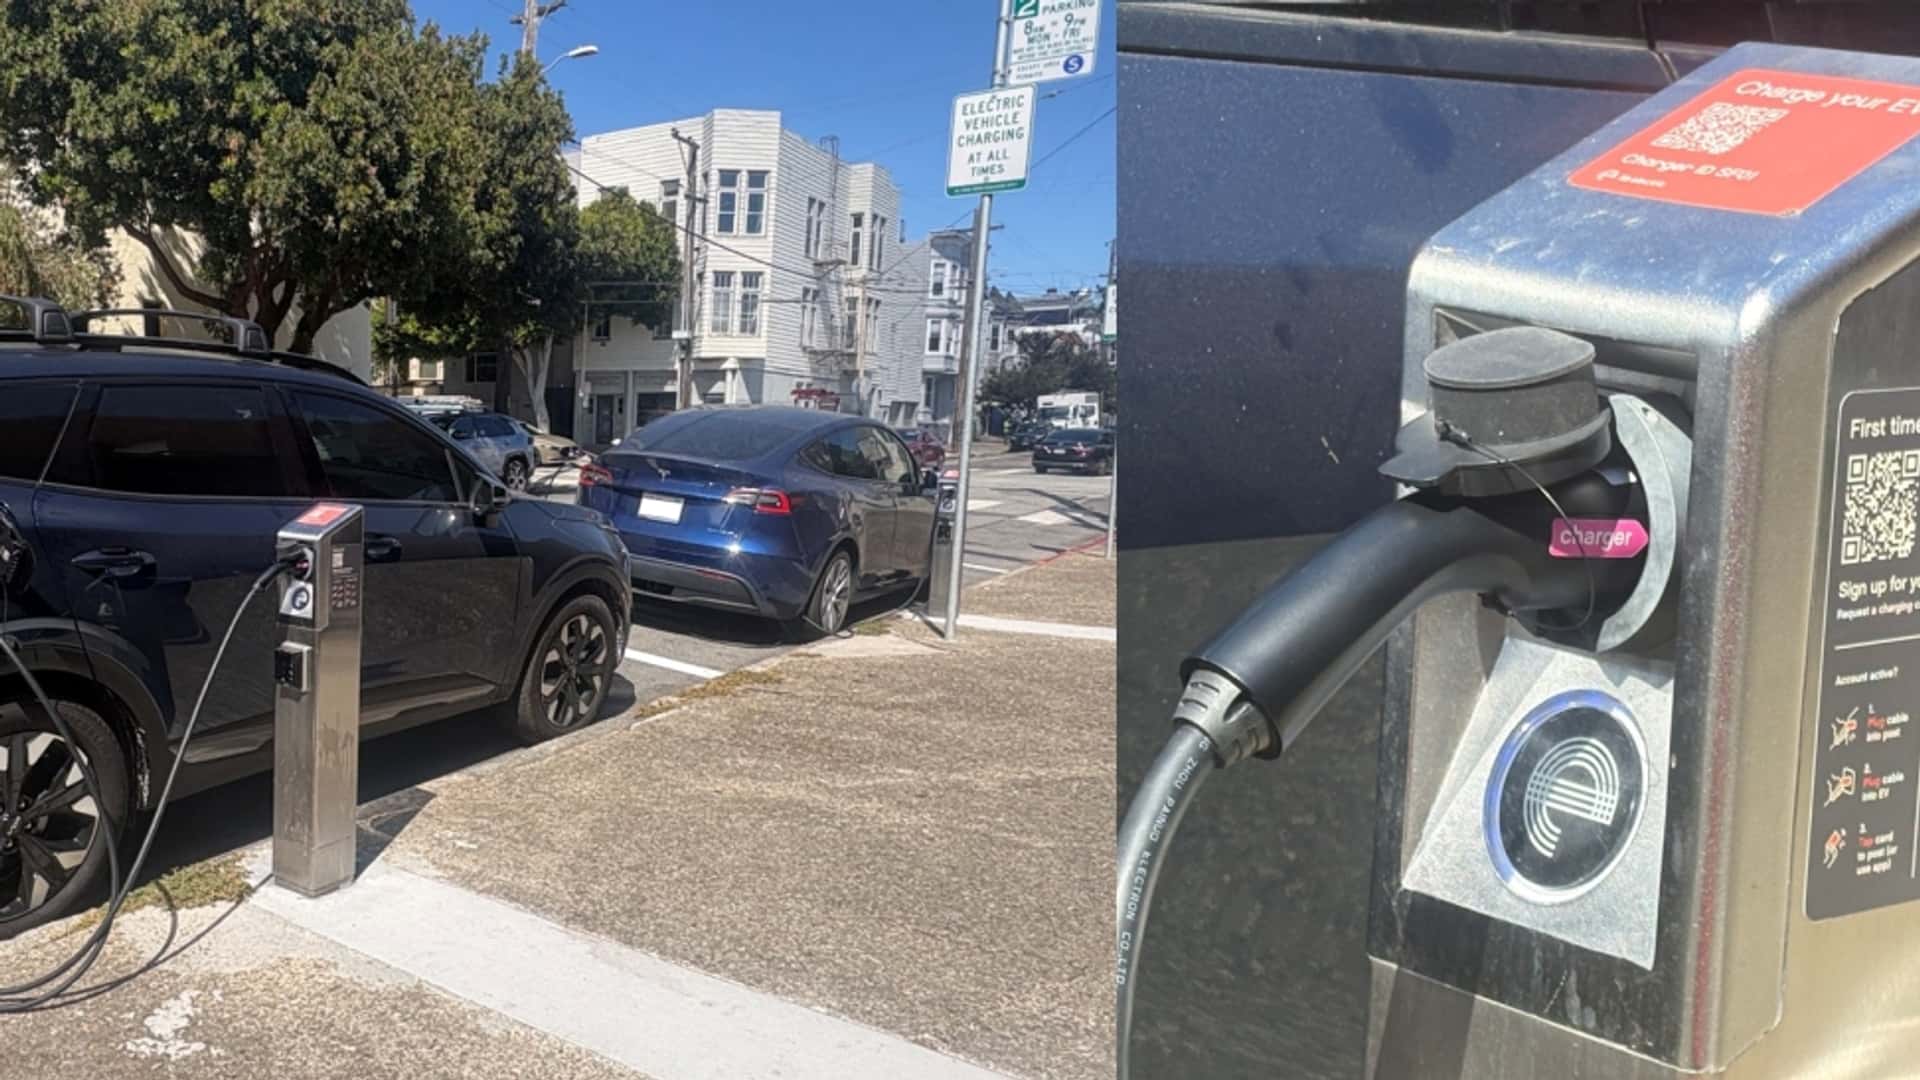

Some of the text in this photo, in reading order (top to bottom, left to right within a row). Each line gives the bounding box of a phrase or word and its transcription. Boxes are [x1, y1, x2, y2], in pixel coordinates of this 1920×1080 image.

[1017, 0, 1096, 16] 2 PARKING
[1027, 32, 1050, 44] MON
[1063, 26, 1081, 39] FRI
[1735, 80, 1826, 104] Charge
[1820, 92, 1889, 108] your
[961, 95, 1025, 116] ELECTRIC
[964, 111, 1020, 130] VEHICLE
[957, 126, 1025, 147] CHARGING
[968, 148, 1009, 164] AT ALL
[1621, 153, 1696, 173] Charger
[1693, 164, 1717, 176] ID
[971, 164, 1005, 177] TIMES
[1850, 417, 1886, 440] First
[1560, 523, 1633, 552] charger
[1838, 580, 1868, 602] Sign
[1870, 580, 1887, 598] up
[1889, 574, 1908, 592] for
[1879, 602, 1913, 615] charging
[1835, 666, 1899, 686] Account active?
[1886, 711, 1910, 725] cable
[1882, 728, 1901, 743] post
[1881, 770, 1905, 784] cable
[1878, 787, 1890, 800] EV
[1875, 830, 1894, 845] card
[1867, 847, 1886, 862] post
[1126, 850, 1152, 922] ELECTRON
